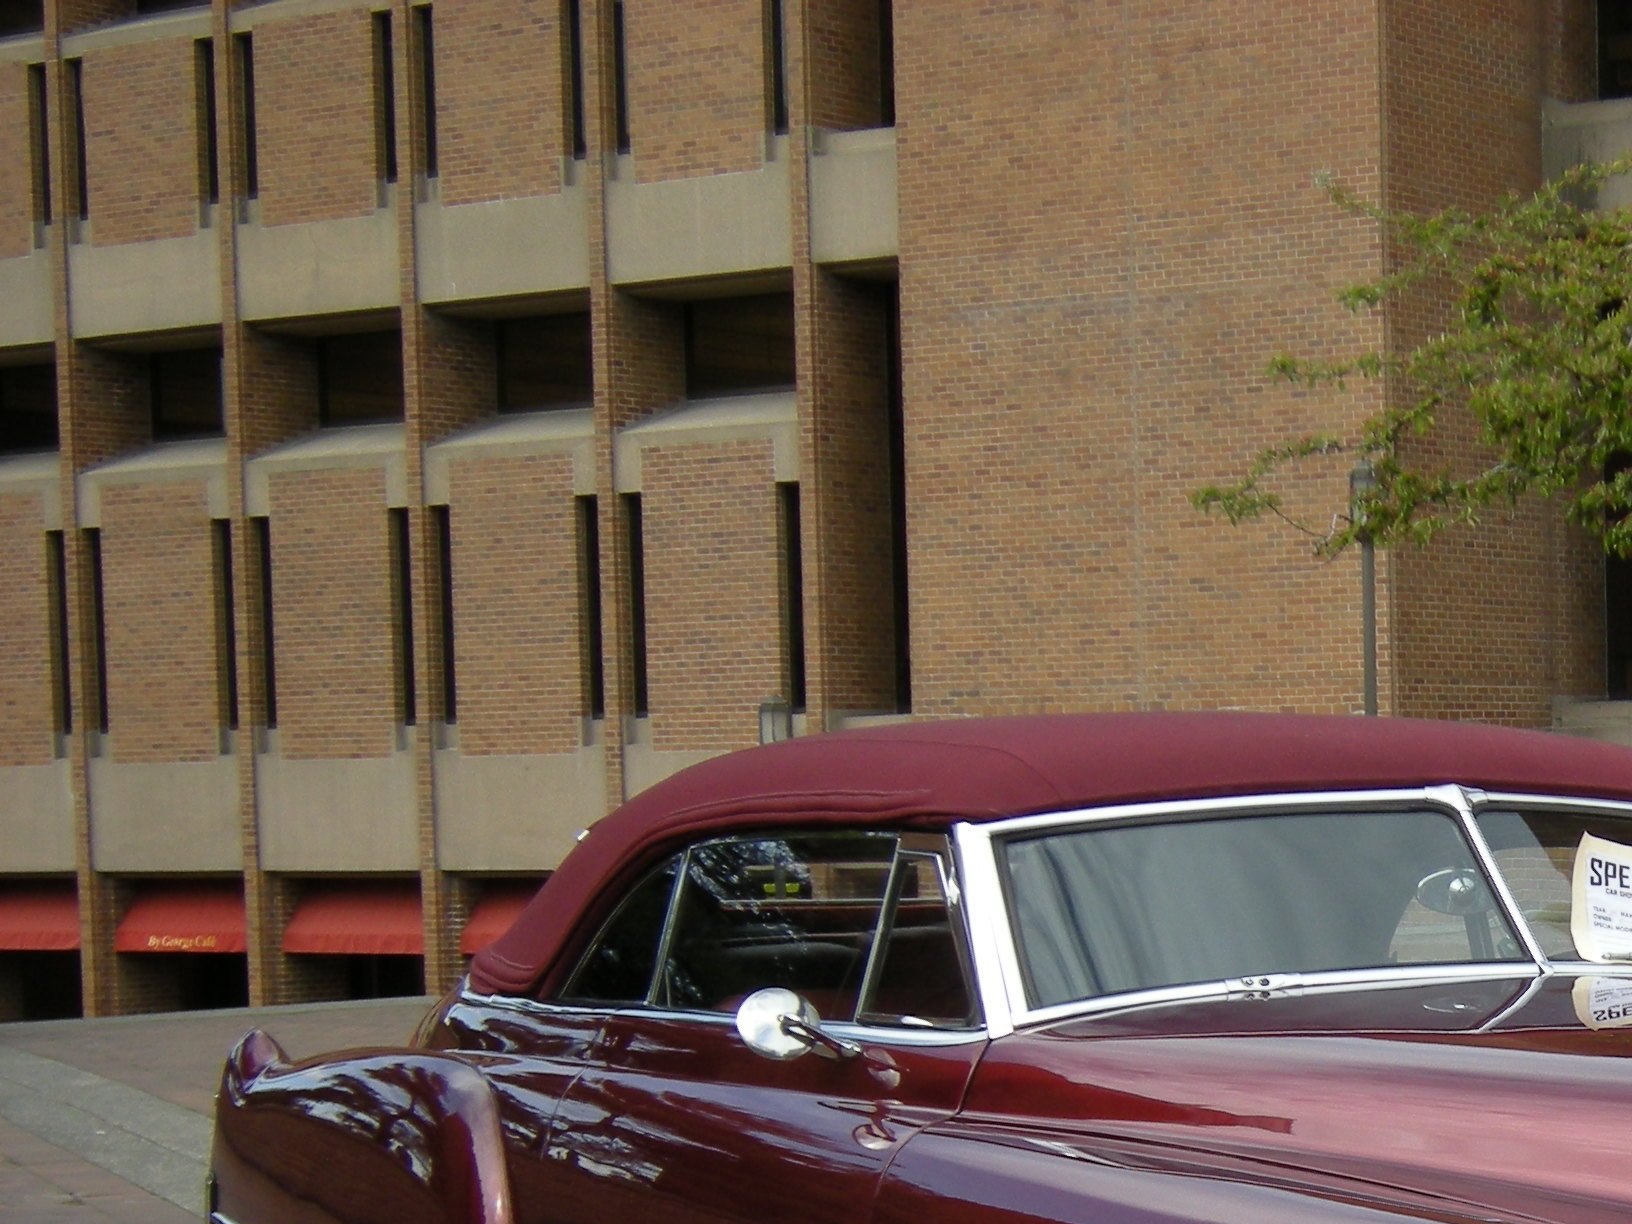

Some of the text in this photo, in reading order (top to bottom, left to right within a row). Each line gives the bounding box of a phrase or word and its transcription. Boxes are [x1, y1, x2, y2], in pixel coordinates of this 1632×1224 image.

[1590, 857, 1630, 889] SPE
[1605, 888, 1617, 896] CAR
[147, 935, 159, 950] By
